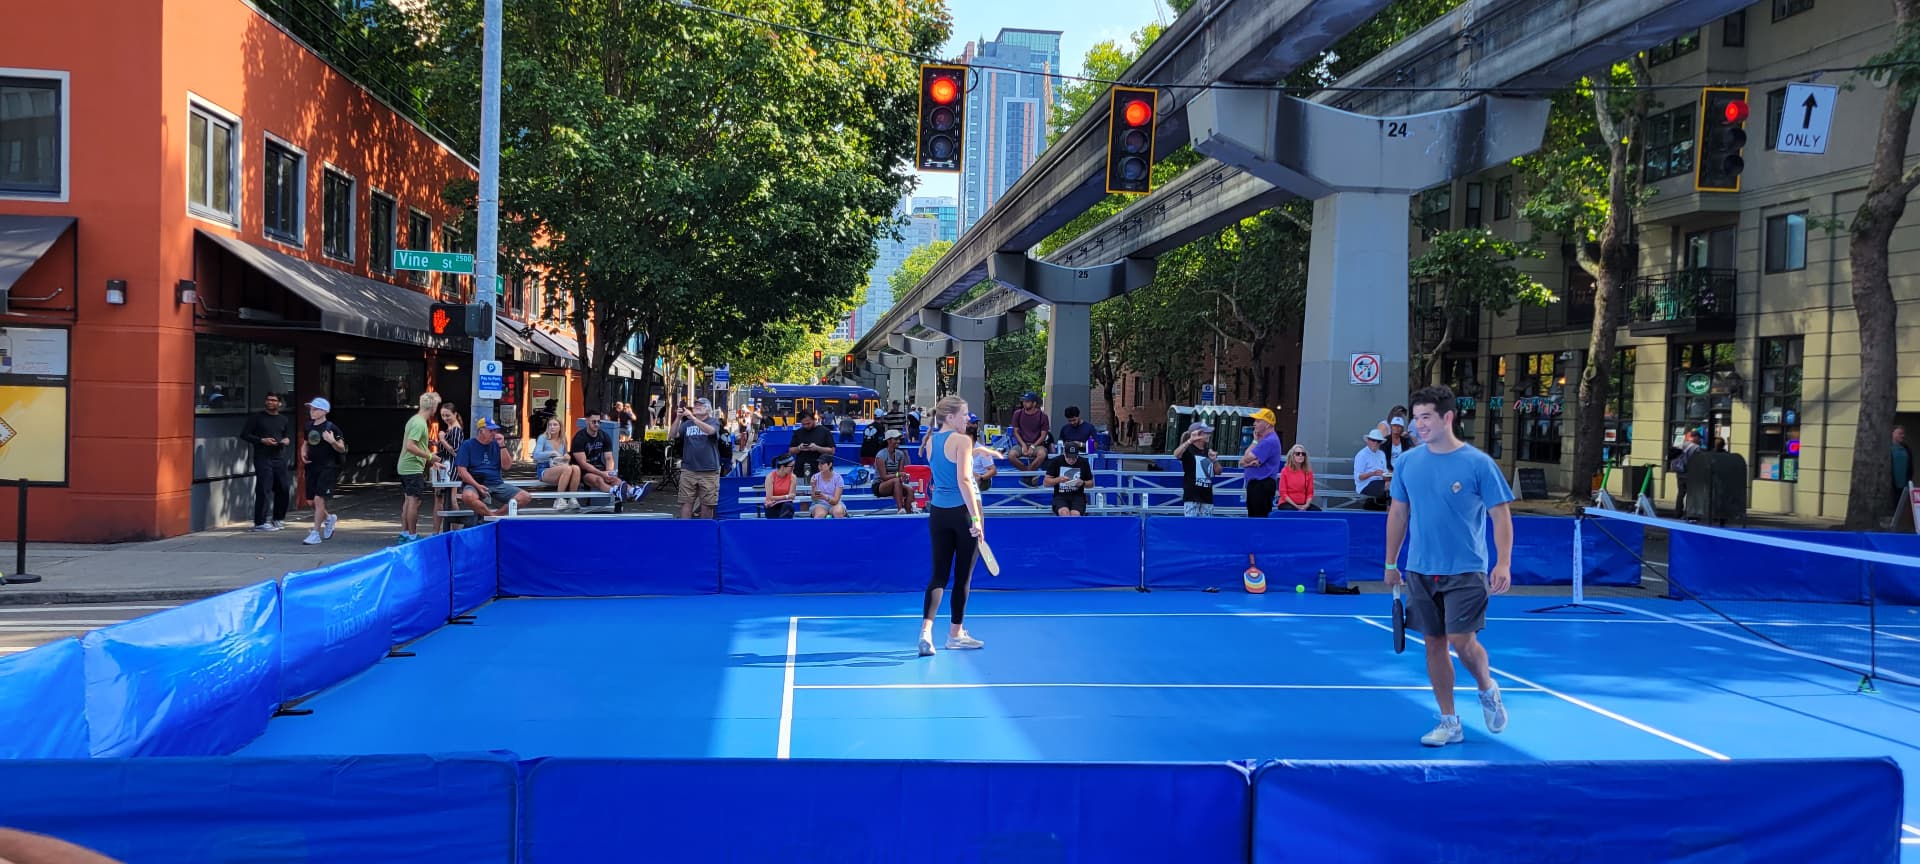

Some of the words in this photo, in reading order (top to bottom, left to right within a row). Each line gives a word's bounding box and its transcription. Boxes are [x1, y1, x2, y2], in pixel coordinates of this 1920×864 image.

[1388, 121, 1408, 137] 24
[1785, 132, 1821, 148] ONLY
[399, 251, 429, 268] Vine
[442, 258, 452, 269] St
[455, 255, 472, 263] 2500
[1078, 270, 1089, 279] 25
